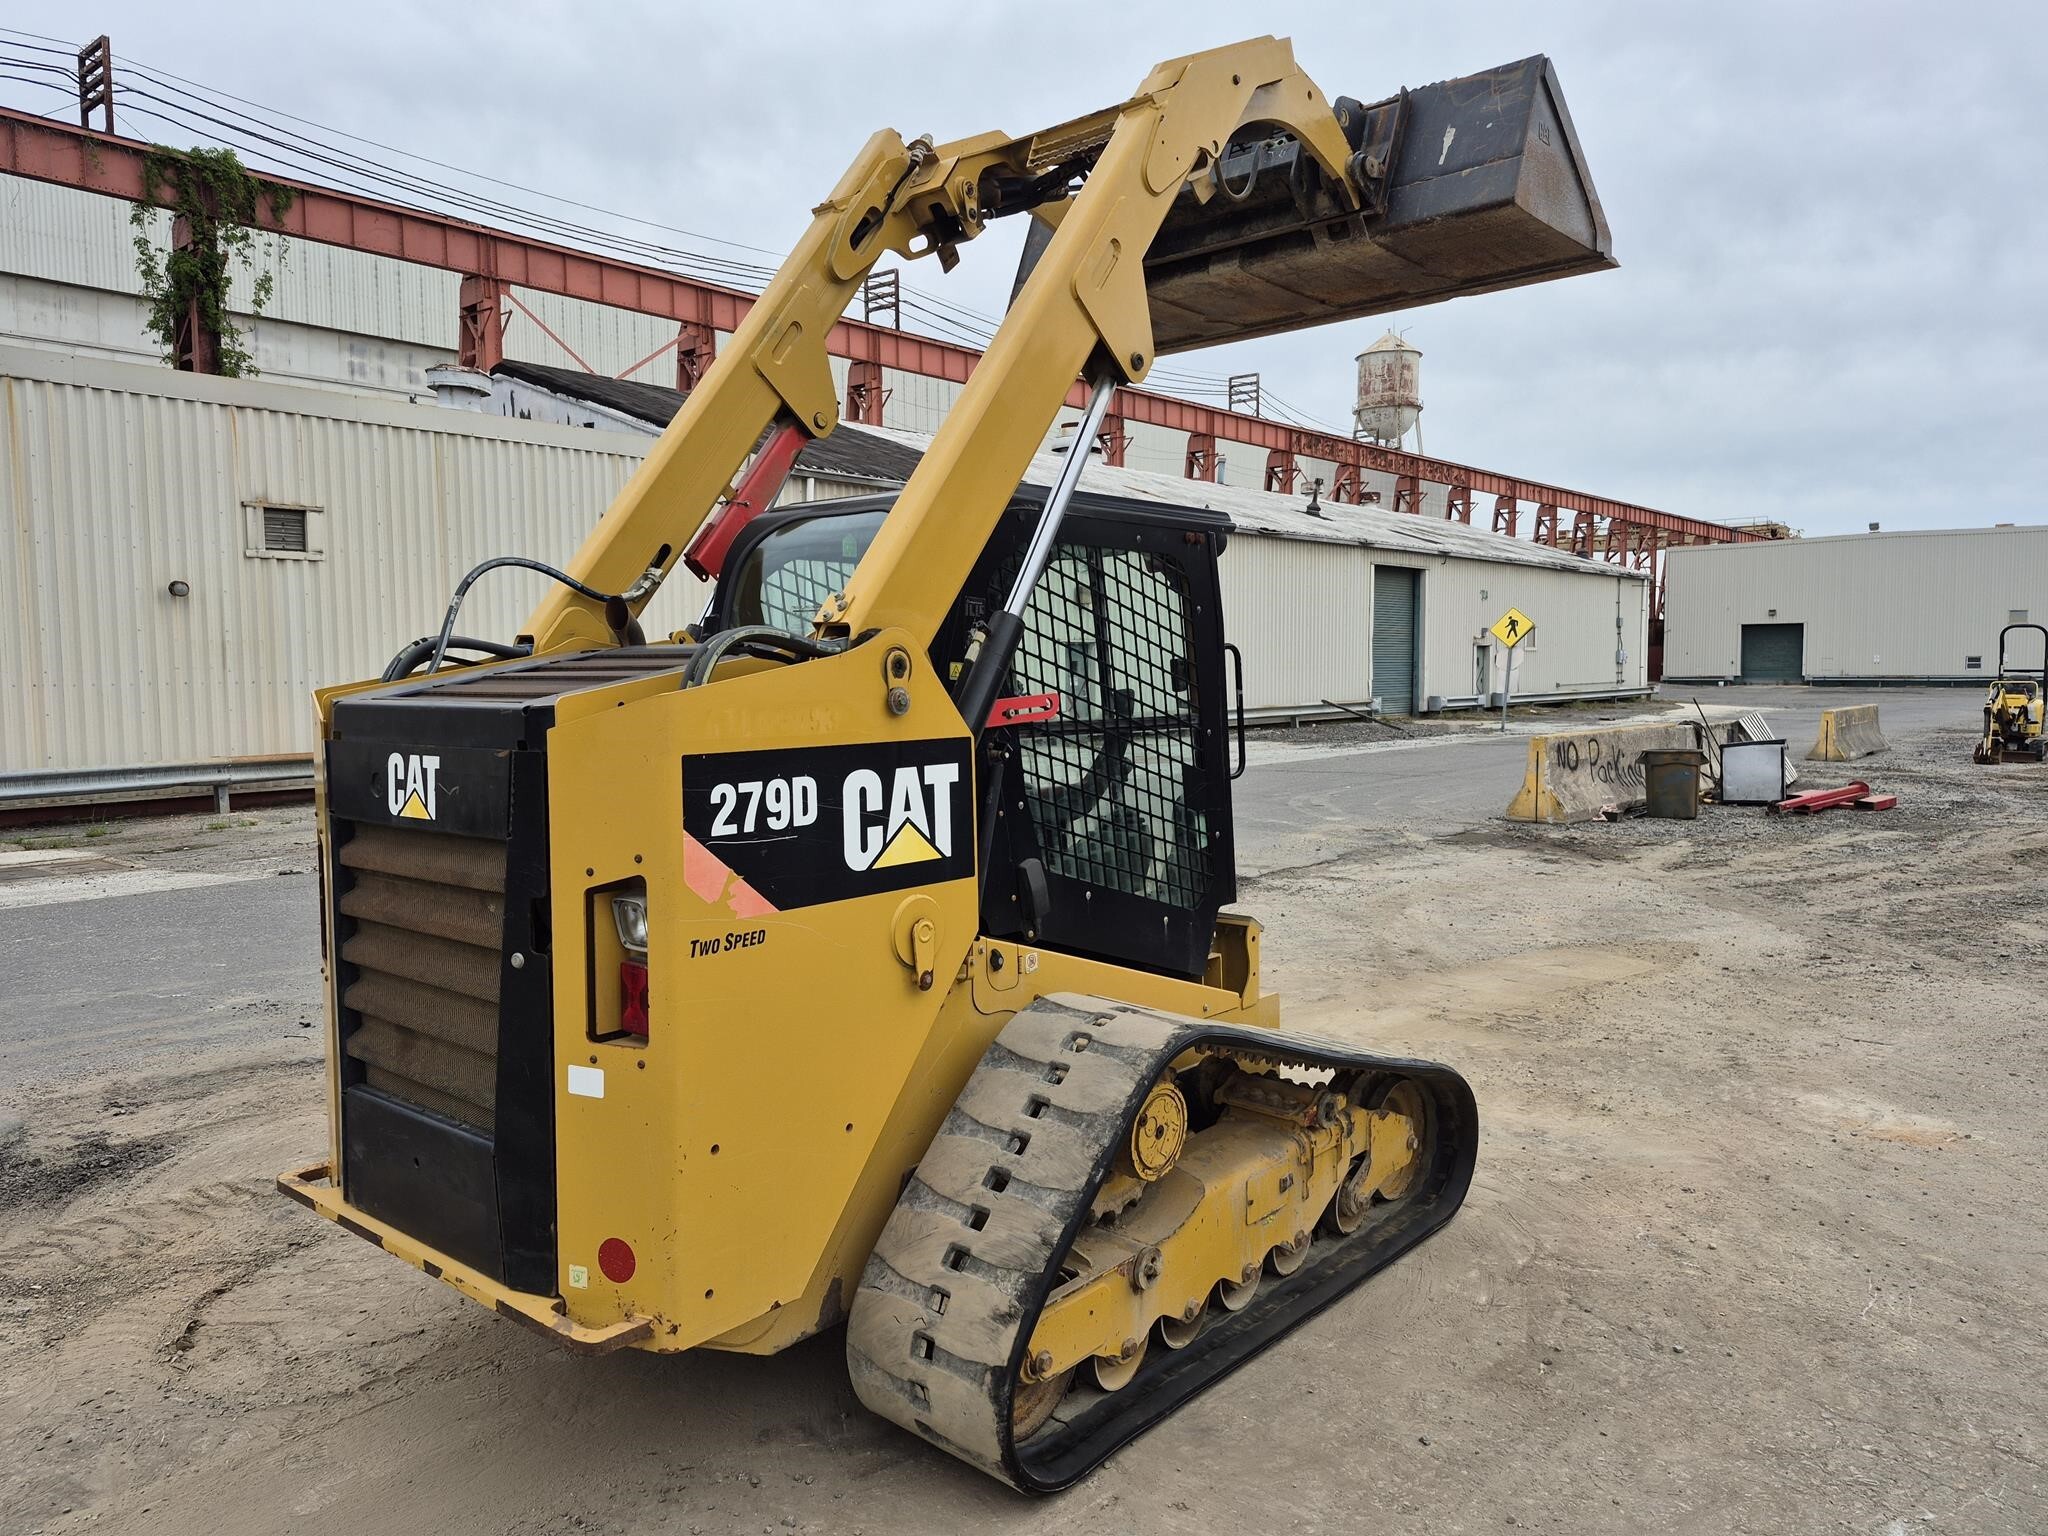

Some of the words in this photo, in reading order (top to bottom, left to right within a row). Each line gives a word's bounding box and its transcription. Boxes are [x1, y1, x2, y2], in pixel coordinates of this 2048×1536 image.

[387, 752, 440, 820] CAT
[1557, 741, 1579, 771] NO
[710, 776, 818, 837] 279D
[842, 762, 959, 872] CAT
